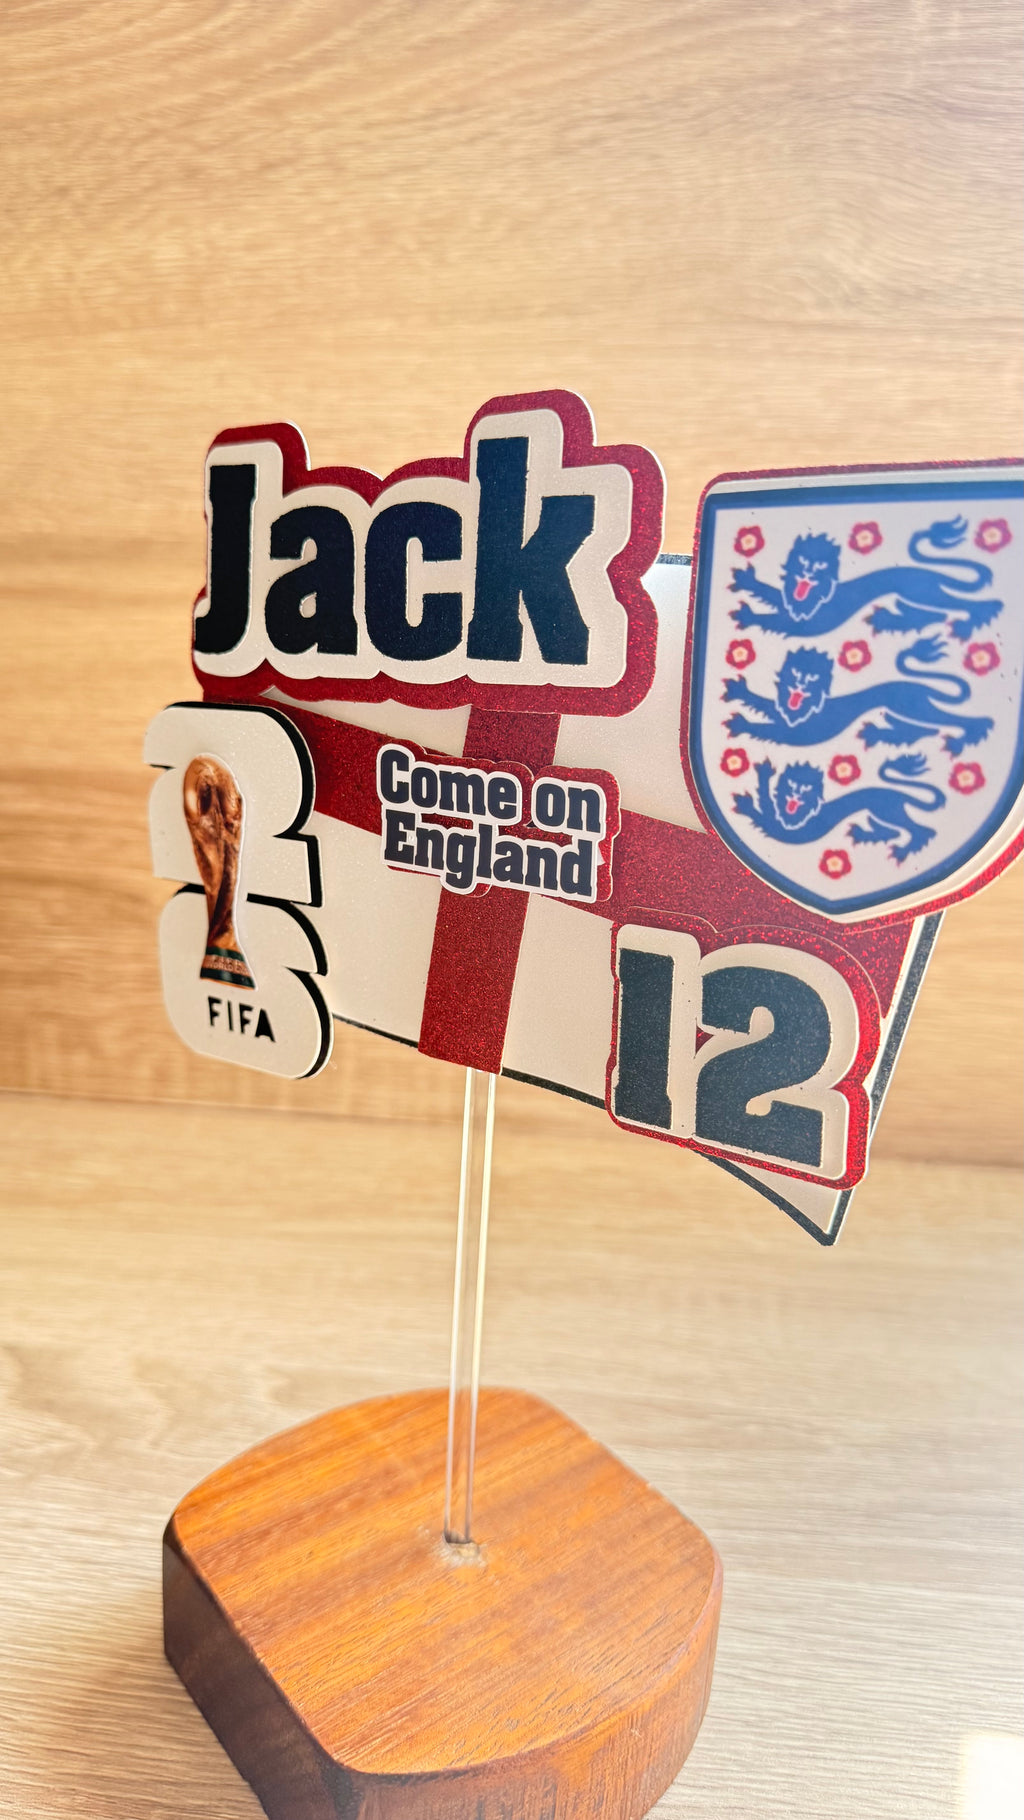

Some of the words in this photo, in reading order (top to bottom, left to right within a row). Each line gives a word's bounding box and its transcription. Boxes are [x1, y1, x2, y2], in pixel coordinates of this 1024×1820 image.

[194, 436, 596, 665] Jack
[380, 749, 518, 820] Come
[535, 783, 601, 834] on
[384, 809, 594, 897] England
[207, 995, 276, 1043] FIFA
[614, 947, 831, 1168] 12
